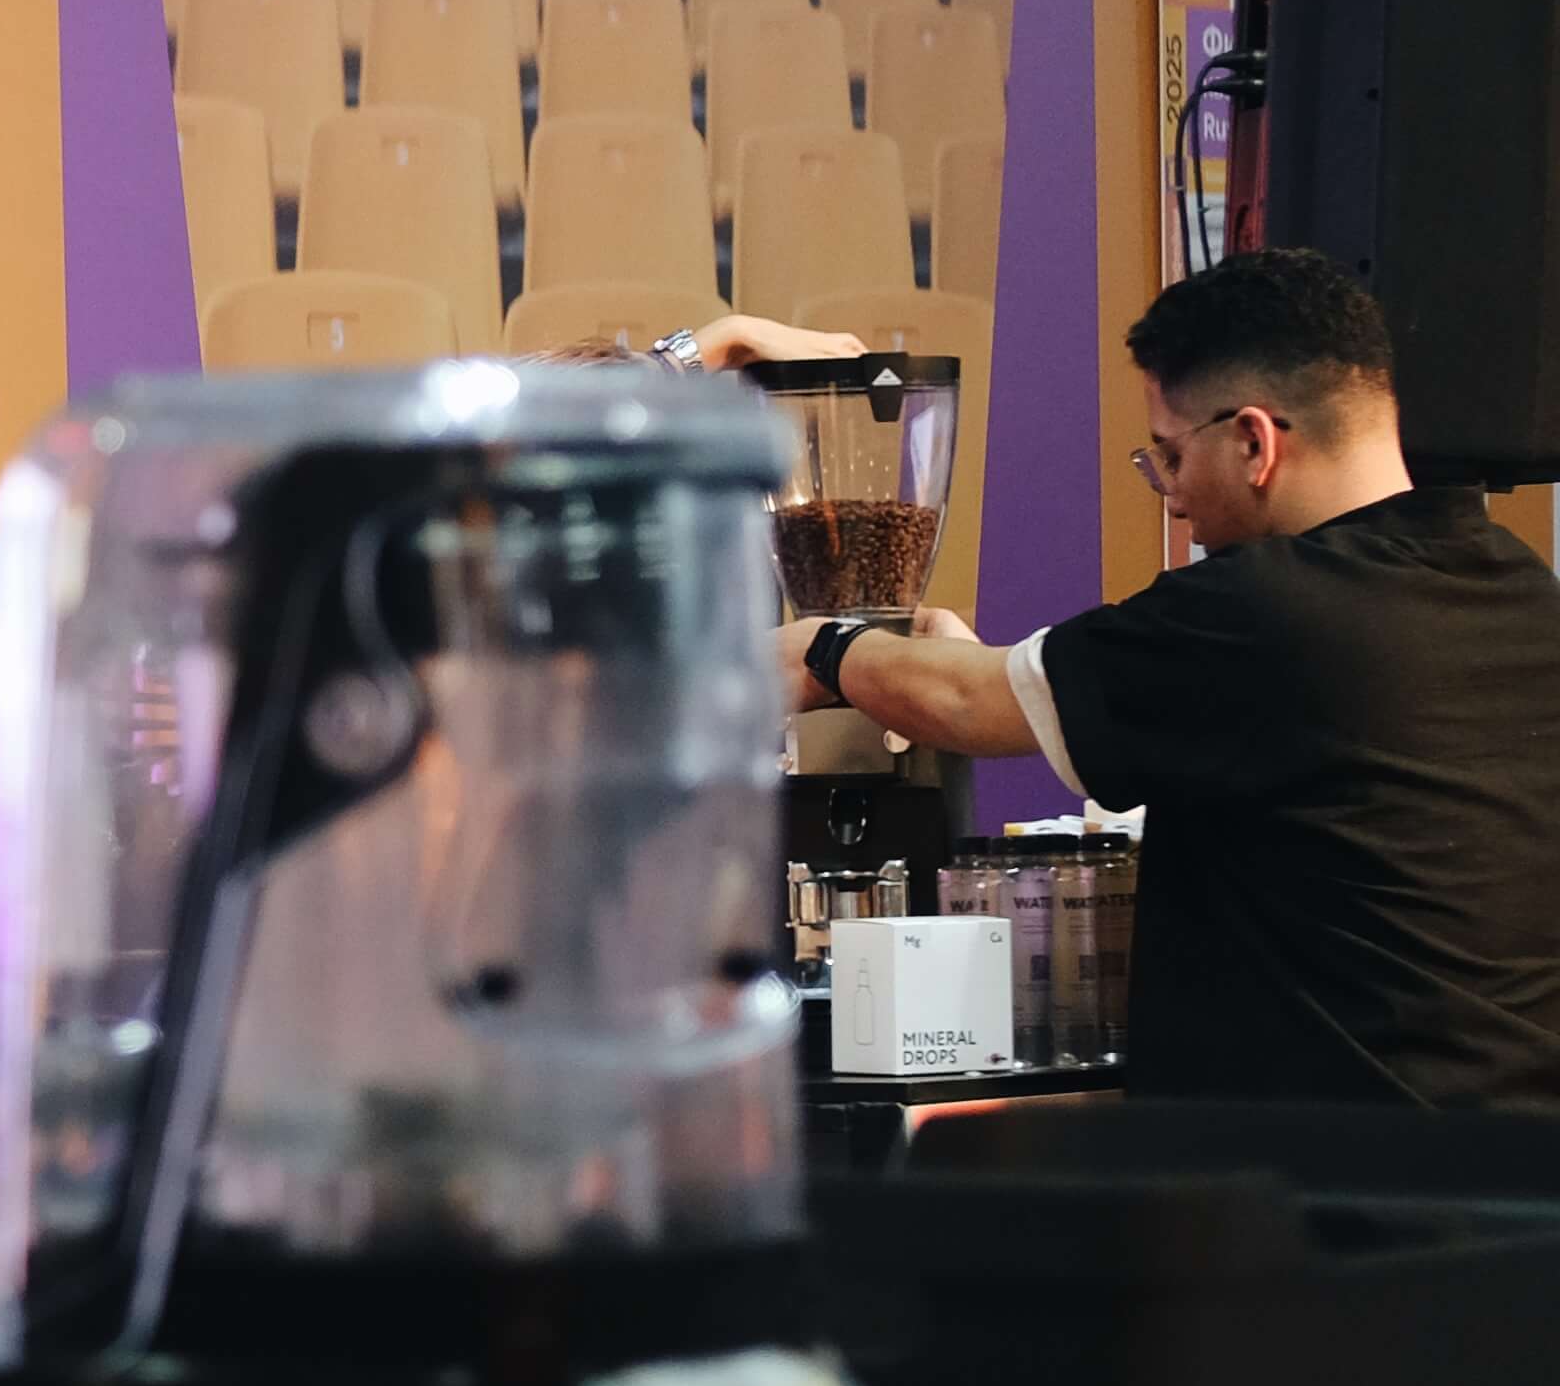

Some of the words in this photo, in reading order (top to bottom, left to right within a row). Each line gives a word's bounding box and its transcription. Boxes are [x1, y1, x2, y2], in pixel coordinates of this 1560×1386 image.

[1167, 34, 1183, 125] 2025
[904, 935, 921, 949] Mg
[903, 1030, 976, 1047] MINERAL
[903, 1048, 957, 1066] DROPS
